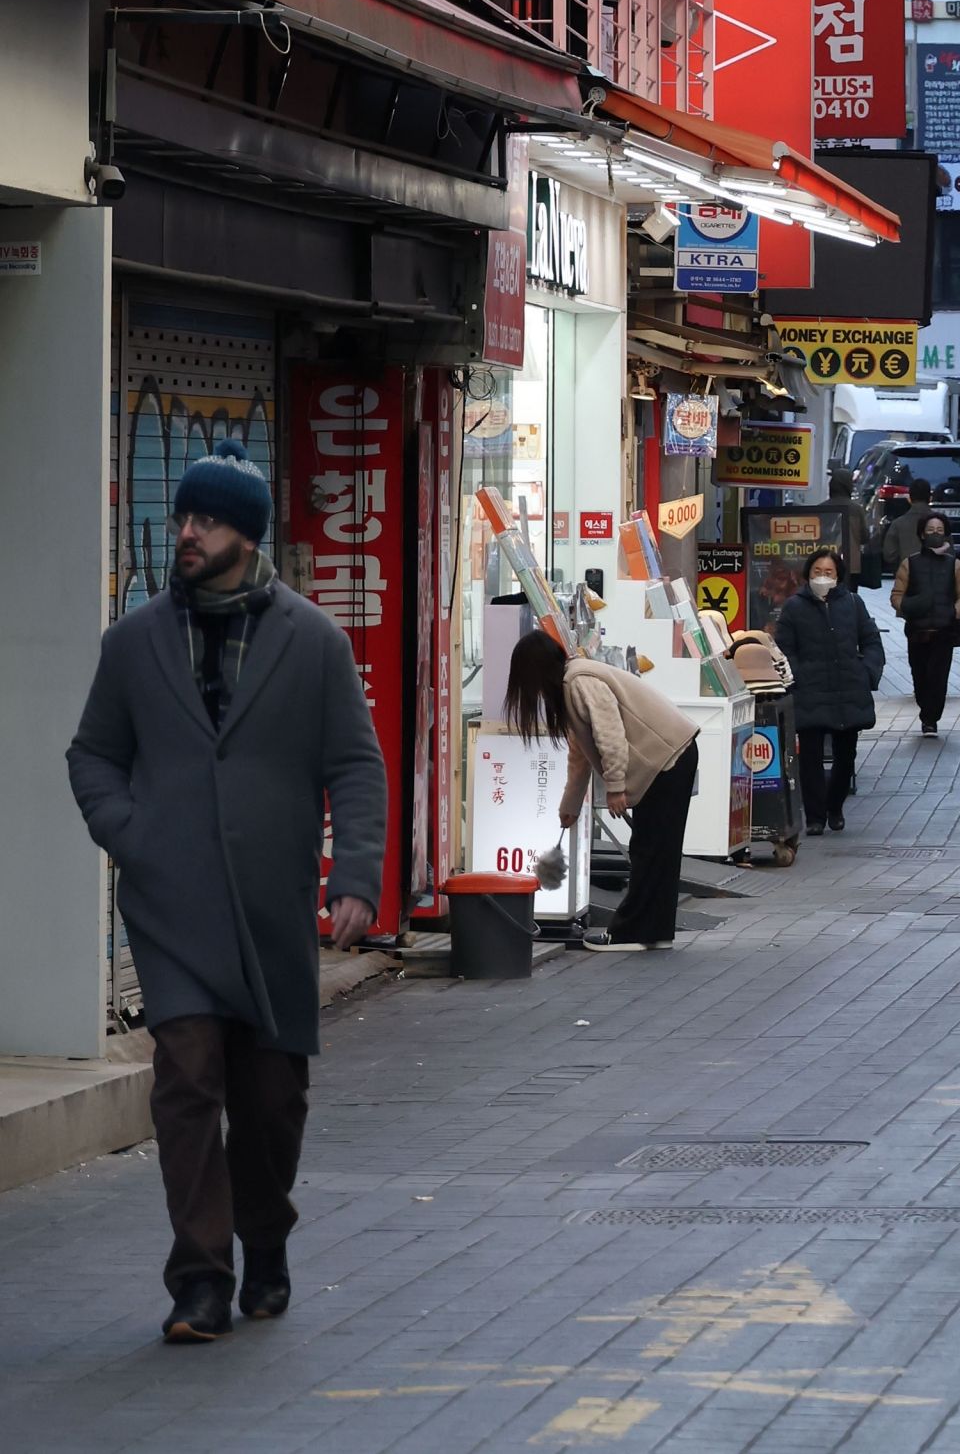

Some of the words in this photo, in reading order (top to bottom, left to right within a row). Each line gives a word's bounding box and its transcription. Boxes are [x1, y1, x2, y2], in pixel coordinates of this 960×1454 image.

[814, 99, 870, 120] 0410
[690, 254, 744, 266] KTRA
[832, 329, 914, 345] EXCHANGE
[741, 466, 801, 478] COMMISSION
[309, 384, 389, 628] 은행골
[585, 520, 608, 529] 에스원
[712, 549, 743, 557] Exchange
